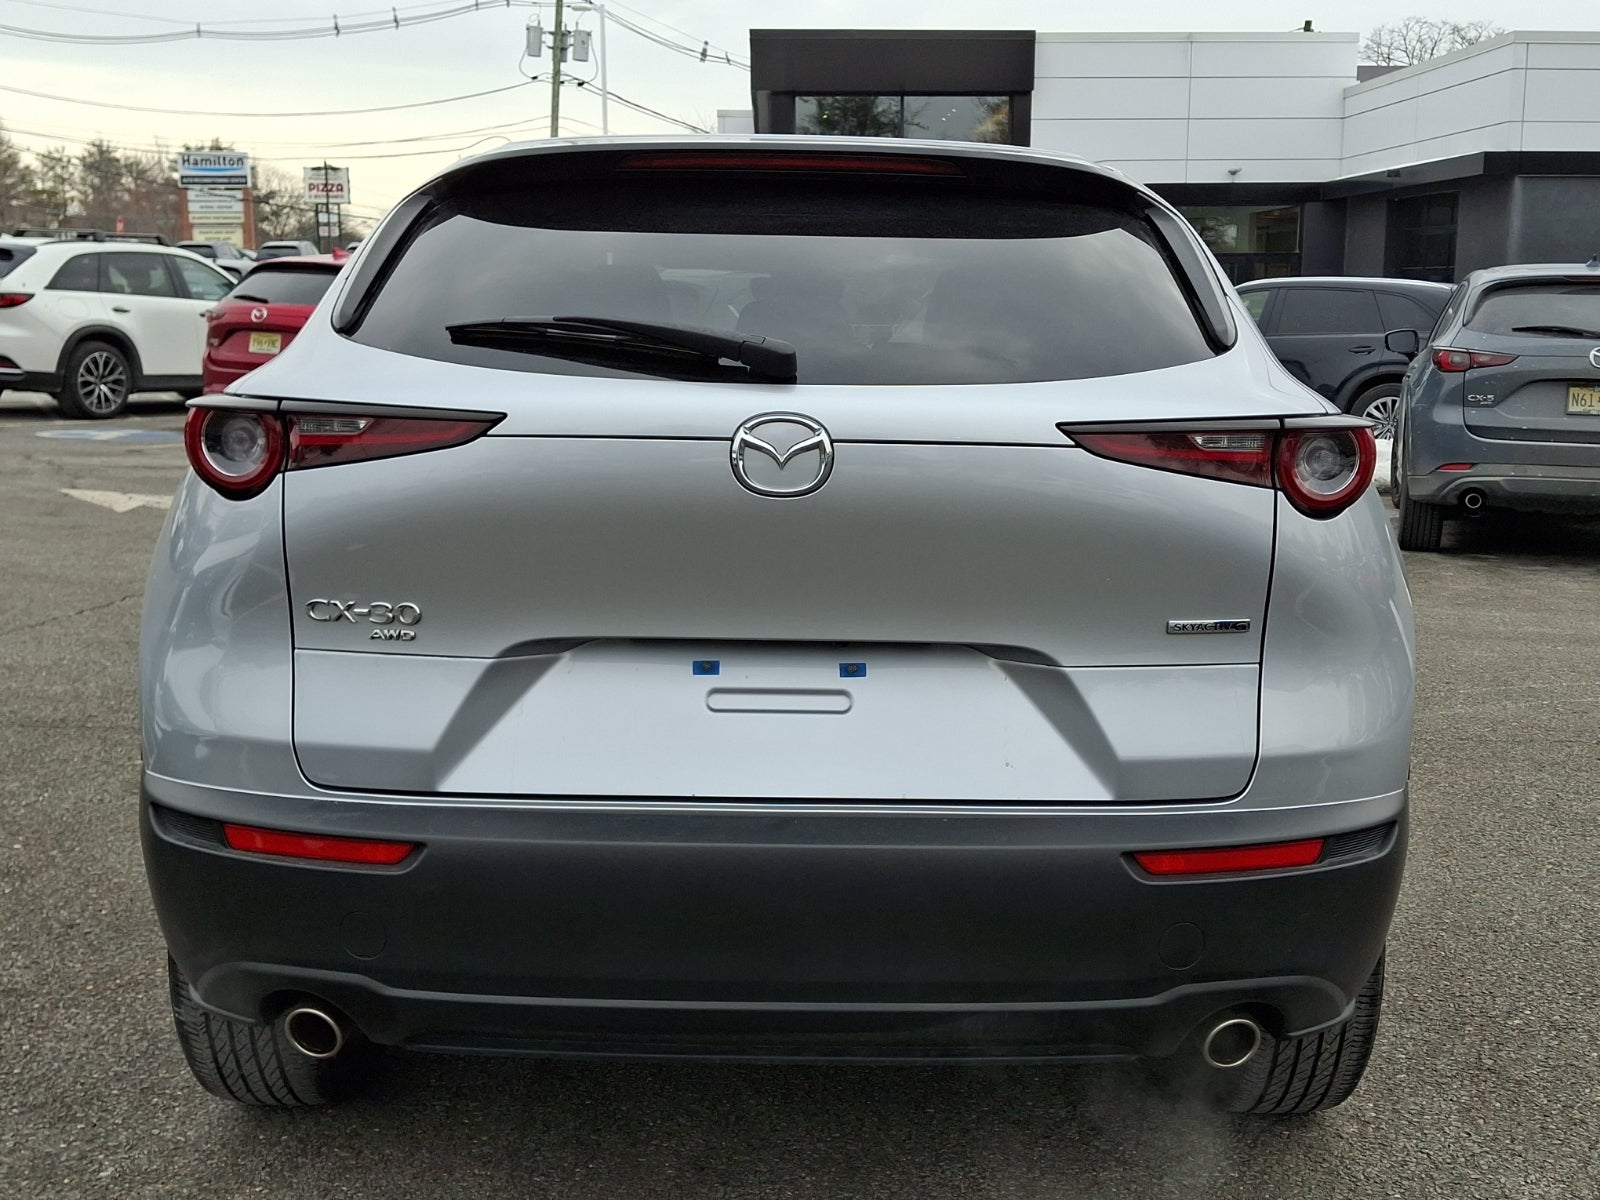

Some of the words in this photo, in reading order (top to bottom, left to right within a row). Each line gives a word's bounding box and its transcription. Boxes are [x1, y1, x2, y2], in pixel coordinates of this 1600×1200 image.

[182, 154, 244, 167] Hamilton
[308, 182, 344, 193] PIZZA
[1467, 394, 1495, 402] CX-5
[1571, 393, 1595, 408] N61
[306, 598, 421, 625] CX-30
[369, 628, 416, 641] AWD
